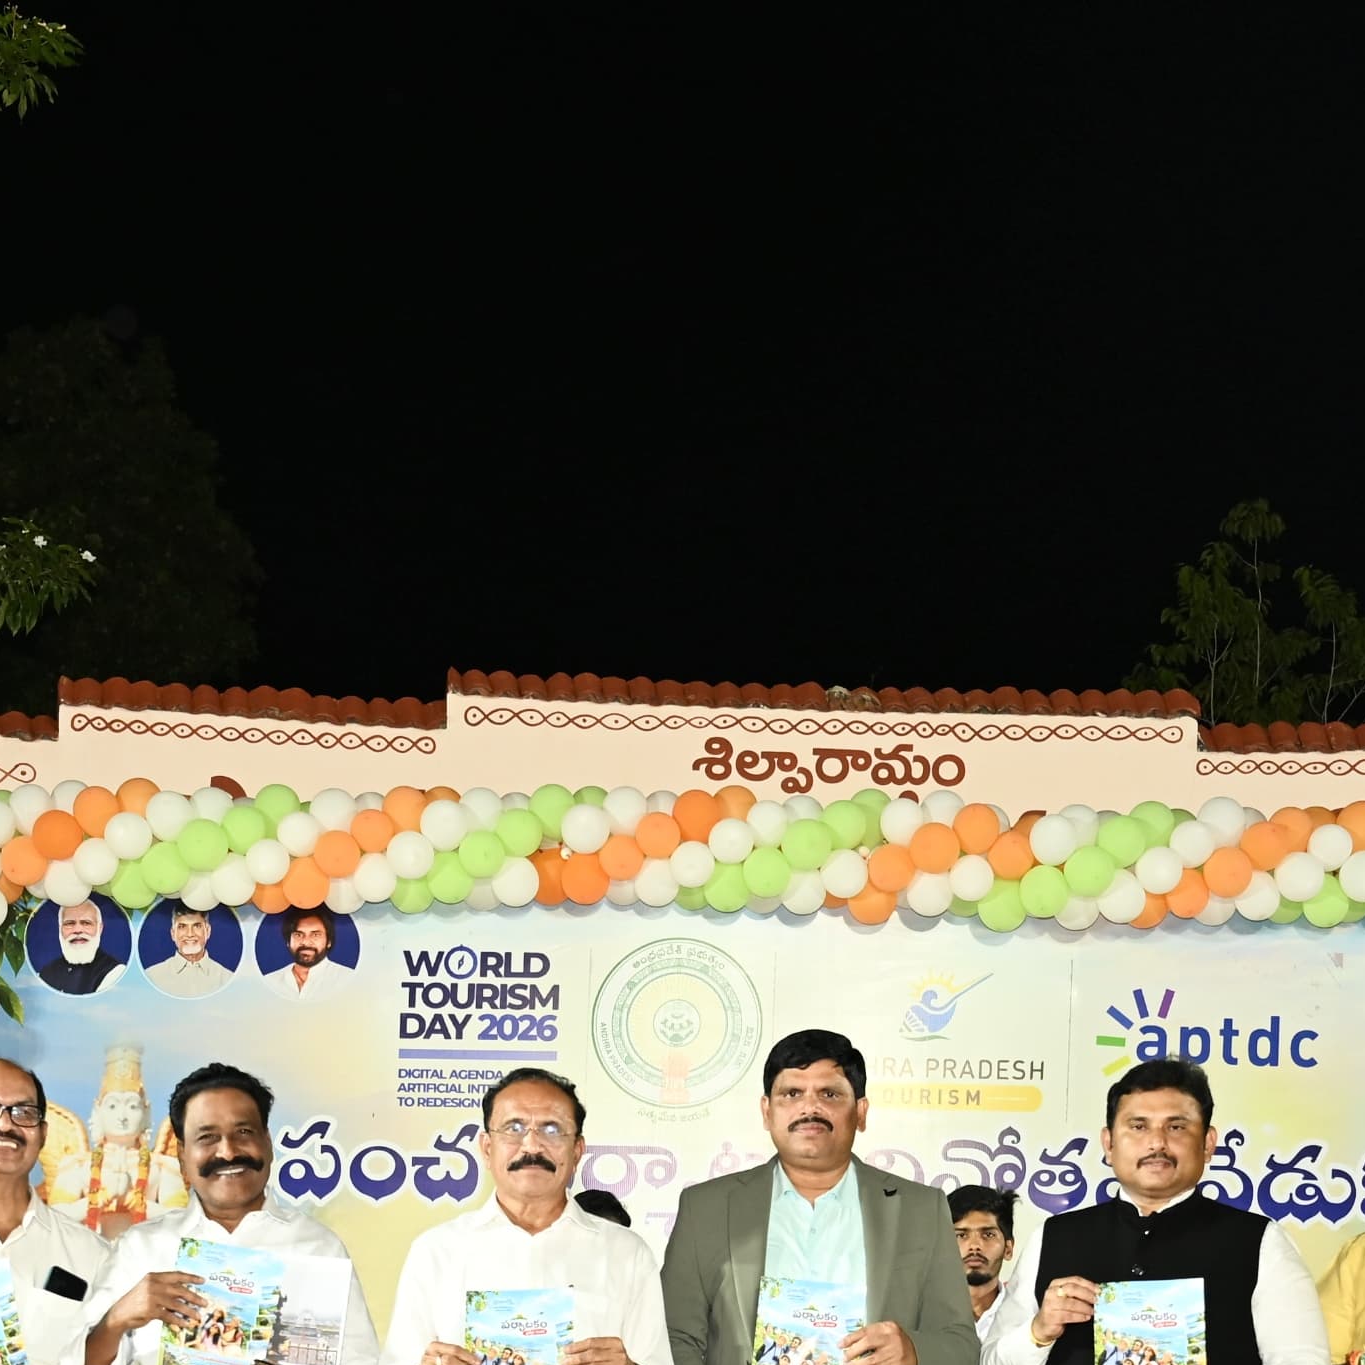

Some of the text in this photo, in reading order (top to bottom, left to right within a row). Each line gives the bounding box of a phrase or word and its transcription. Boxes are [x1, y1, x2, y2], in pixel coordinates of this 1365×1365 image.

[692, 737, 965, 794] శిల్పారామం
[403, 944, 550, 980] WORLD
[401, 982, 560, 1011] TOURISM
[399, 1013, 558, 1041] DAY 2026
[1136, 1016, 1319, 1068] aptdc
[398, 1068, 504, 1080] DIGITAL AGENDA
[925, 1058, 1045, 1081] PRADESH
[397, 1083, 465, 1093] ARTIFICIAL
[882, 1087, 982, 1107] OURISM
[397, 1096, 481, 1108] TO REDESIGN
